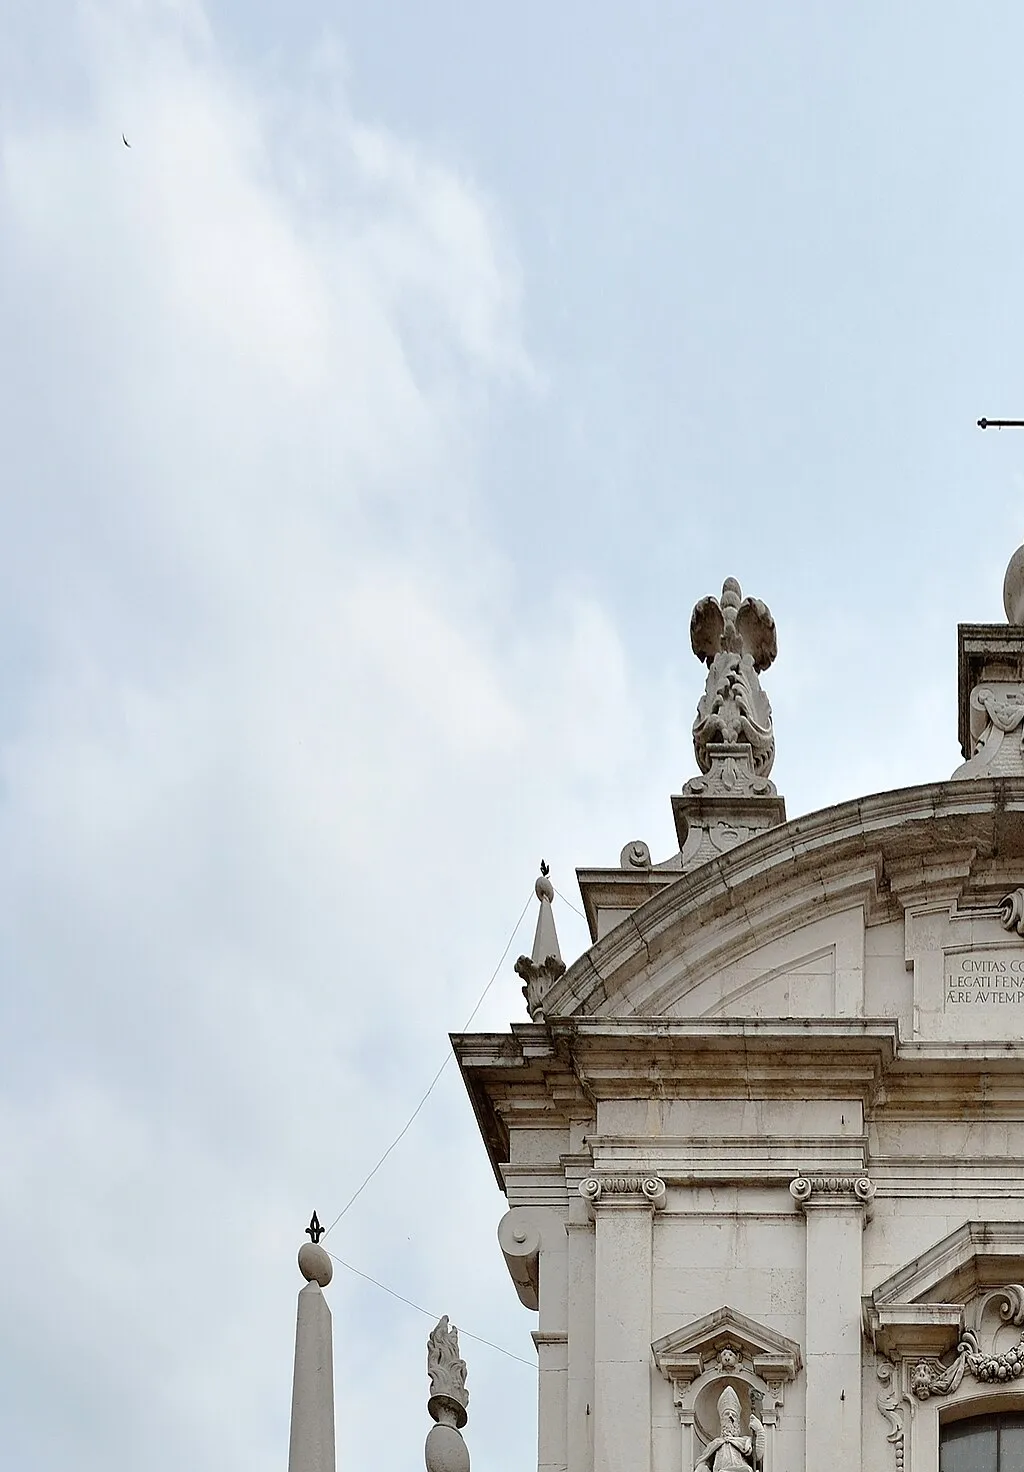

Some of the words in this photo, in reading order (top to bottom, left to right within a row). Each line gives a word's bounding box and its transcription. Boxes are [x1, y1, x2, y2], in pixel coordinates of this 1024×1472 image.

[961, 959, 1006, 972] CIVITAS
[949, 975, 991, 988] LEGATI
[946, 990, 972, 1003] ÆRE
[975, 990, 1015, 1003] AVTEM
